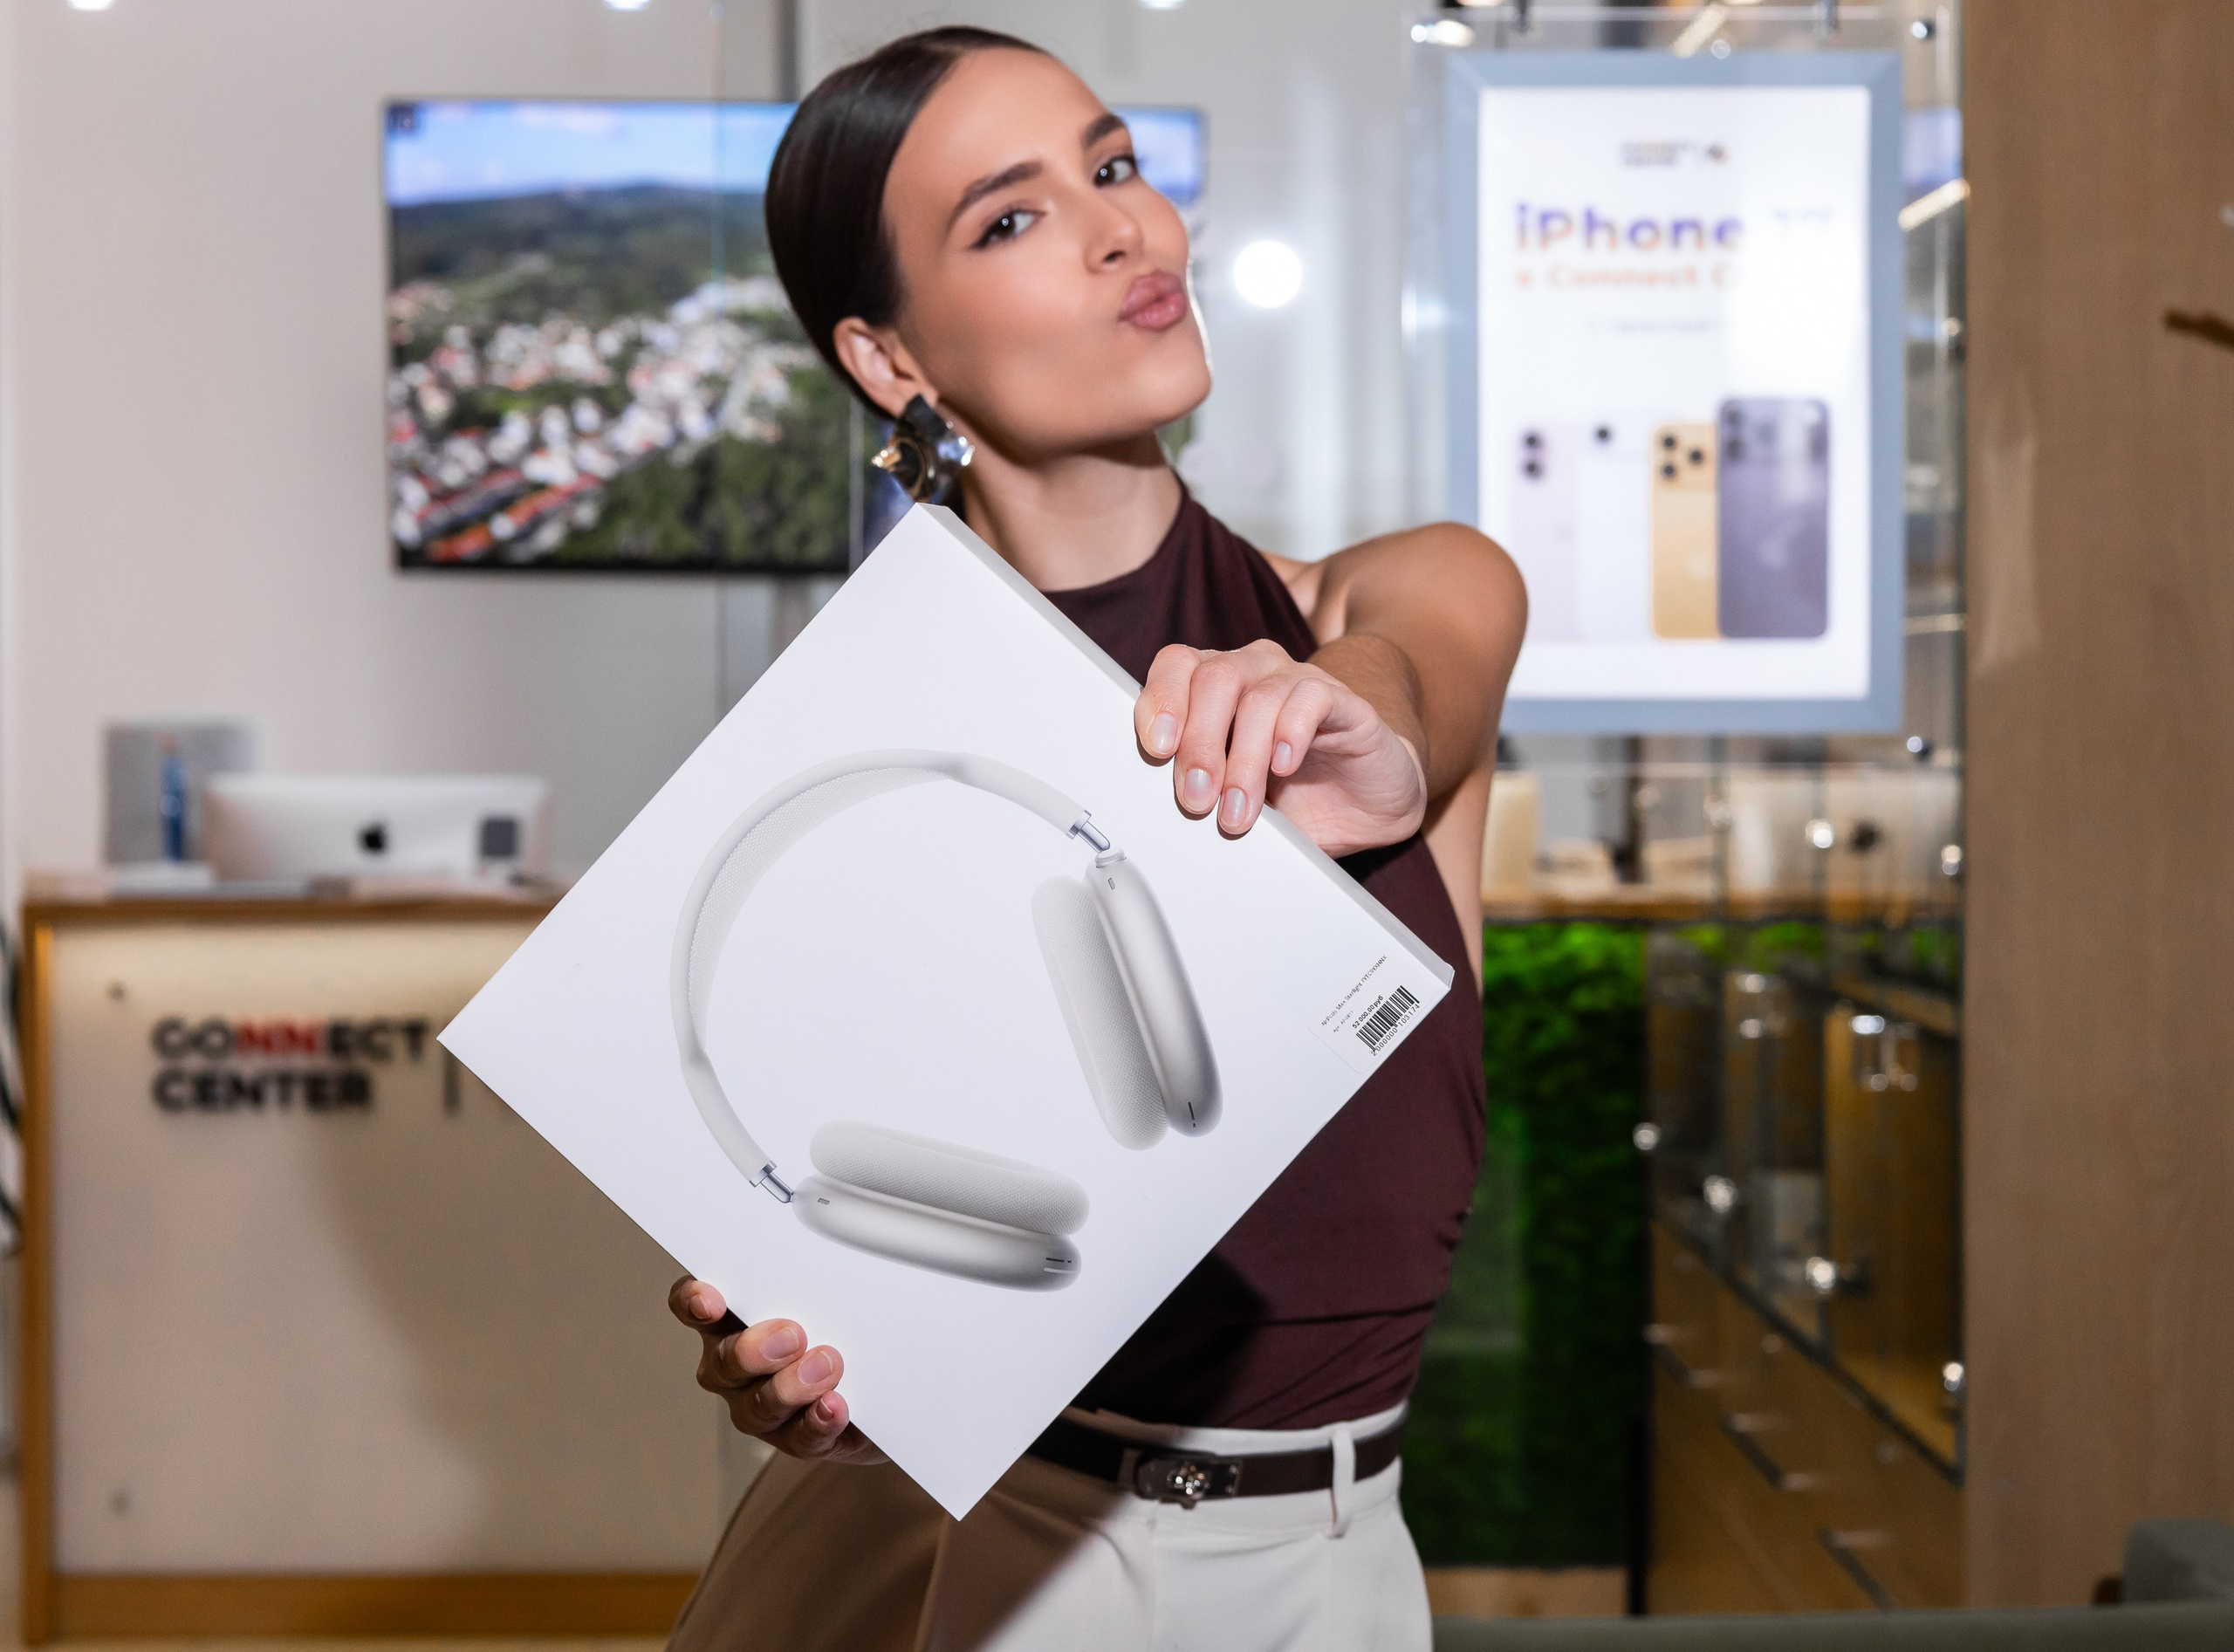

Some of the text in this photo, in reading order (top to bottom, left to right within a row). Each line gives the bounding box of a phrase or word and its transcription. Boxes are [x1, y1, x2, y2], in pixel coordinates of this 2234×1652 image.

[1516, 199, 1744, 252] iPhone
[1336, 999, 1347, 1011] Max
[1345, 981, 1363, 1002] Starlight
[152, 1016, 429, 1062] CONNECT
[1352, 1018, 1361, 1030] 52
[152, 1068, 373, 1112] CENTER
